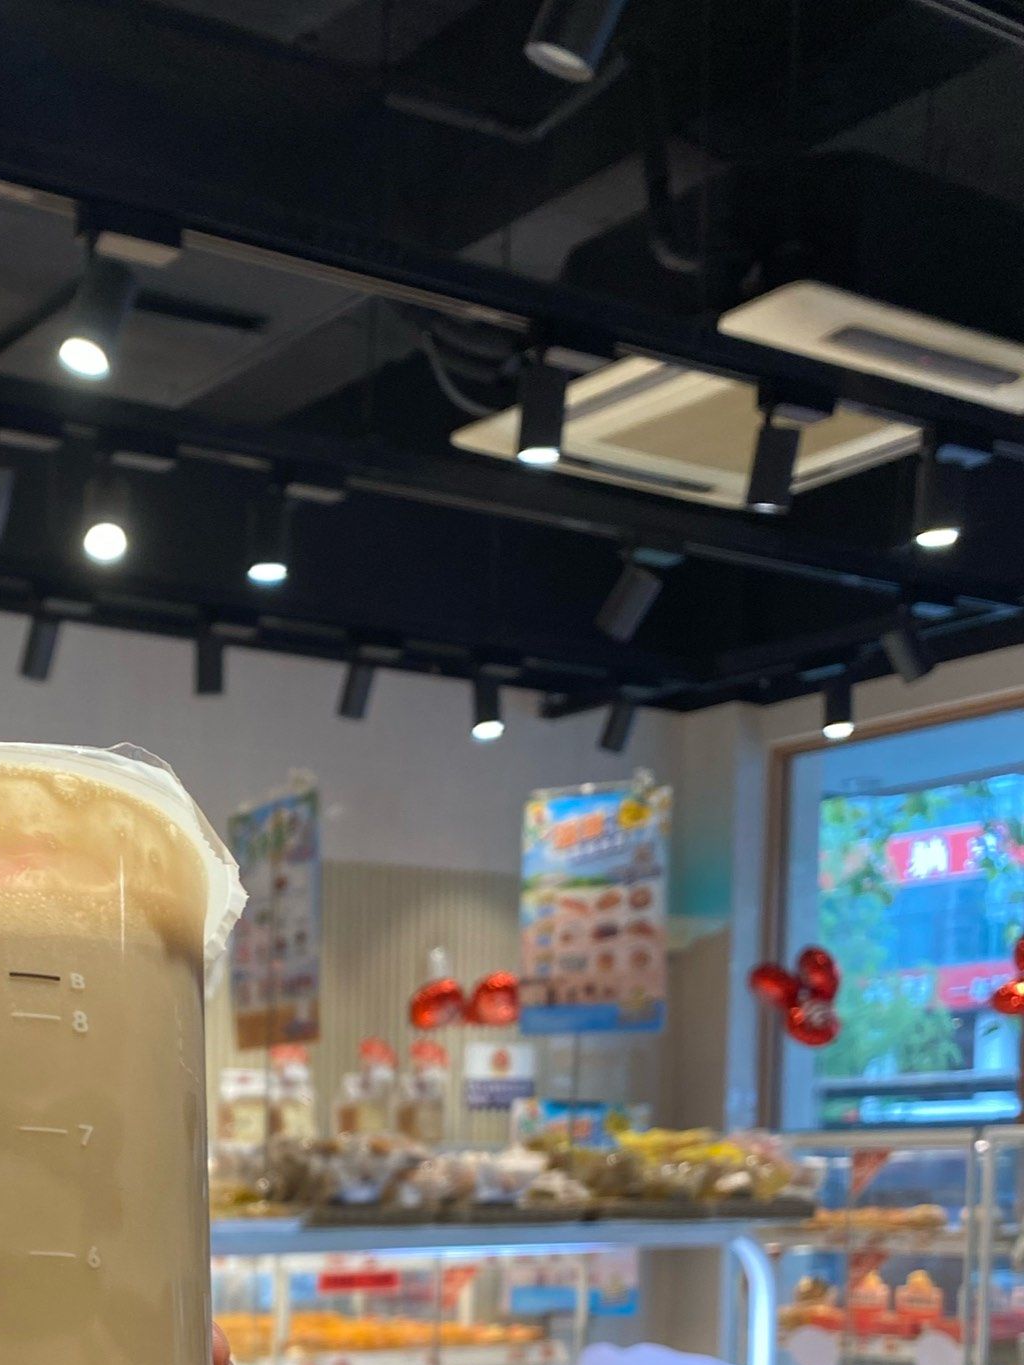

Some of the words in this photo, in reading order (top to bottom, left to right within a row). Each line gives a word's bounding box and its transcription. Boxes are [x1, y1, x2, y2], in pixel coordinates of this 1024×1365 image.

[72, 1011, 88, 1032] 8
[78, 1124, 93, 1146] 7
[87, 1246, 101, 1268] 6
